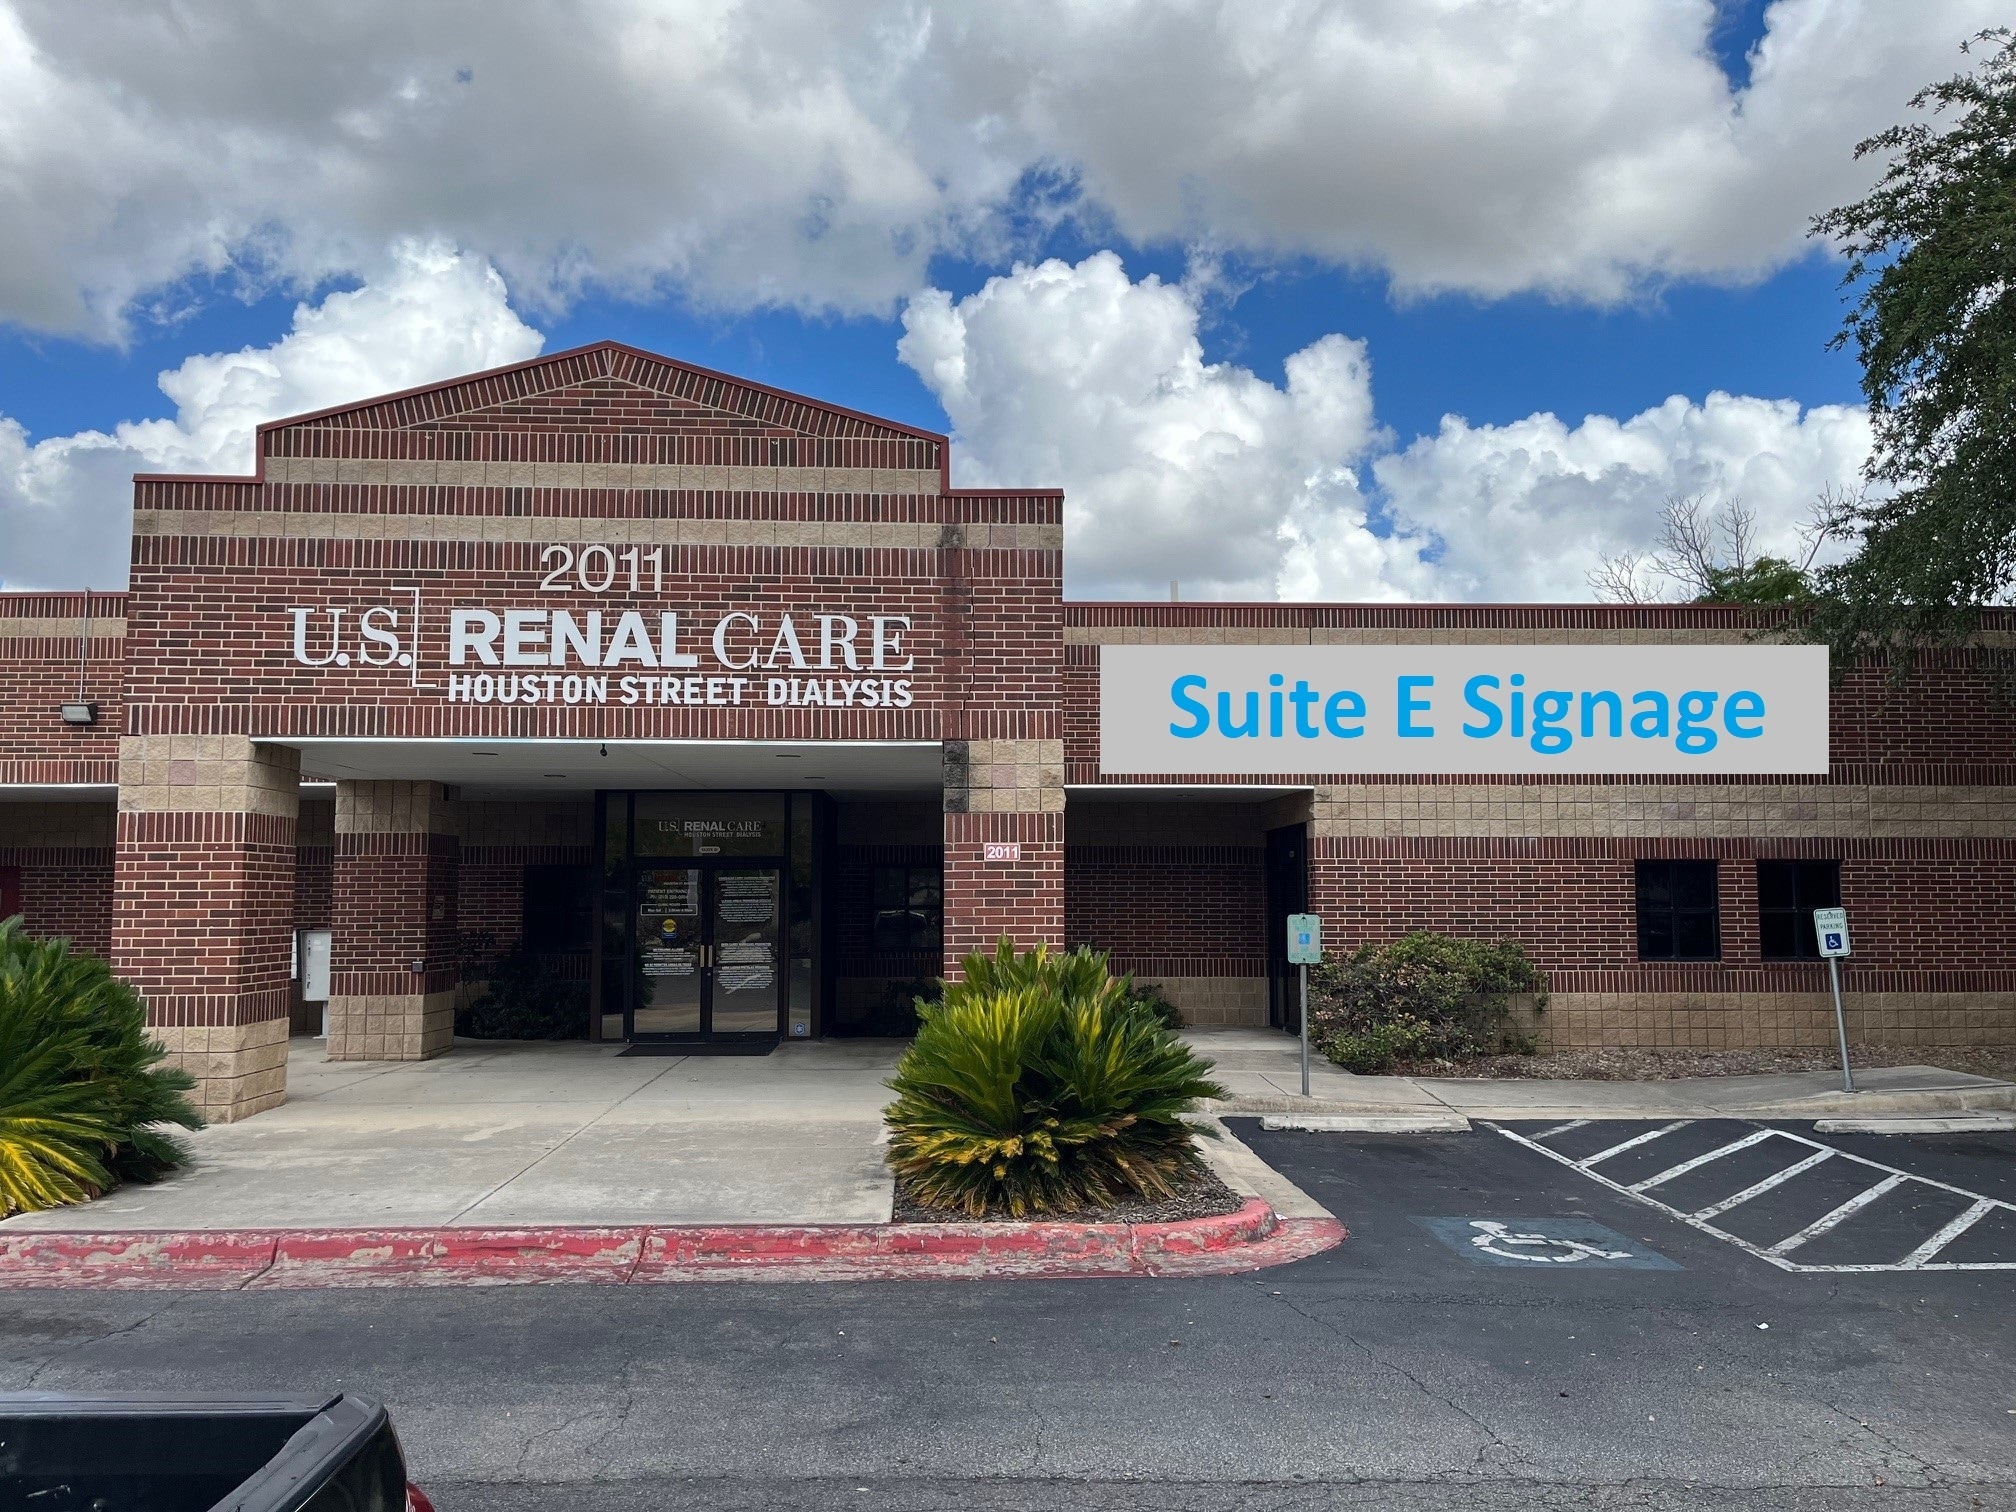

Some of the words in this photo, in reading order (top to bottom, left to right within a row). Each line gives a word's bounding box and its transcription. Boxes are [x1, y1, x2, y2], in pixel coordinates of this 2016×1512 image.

[539, 544, 663, 593] 2011
[287, 606, 413, 667] U.S.
[449, 609, 699, 669] RENAL
[712, 612, 915, 672] CARE
[448, 674, 607, 704] HOUSTON
[619, 675, 749, 706] STREET
[767, 677, 914, 708] DIALYSIS
[658, 820, 679, 832] U.S.
[684, 821, 726, 832] RENAL
[727, 820, 762, 832] CARE
[986, 845, 1018, 859] 2011
